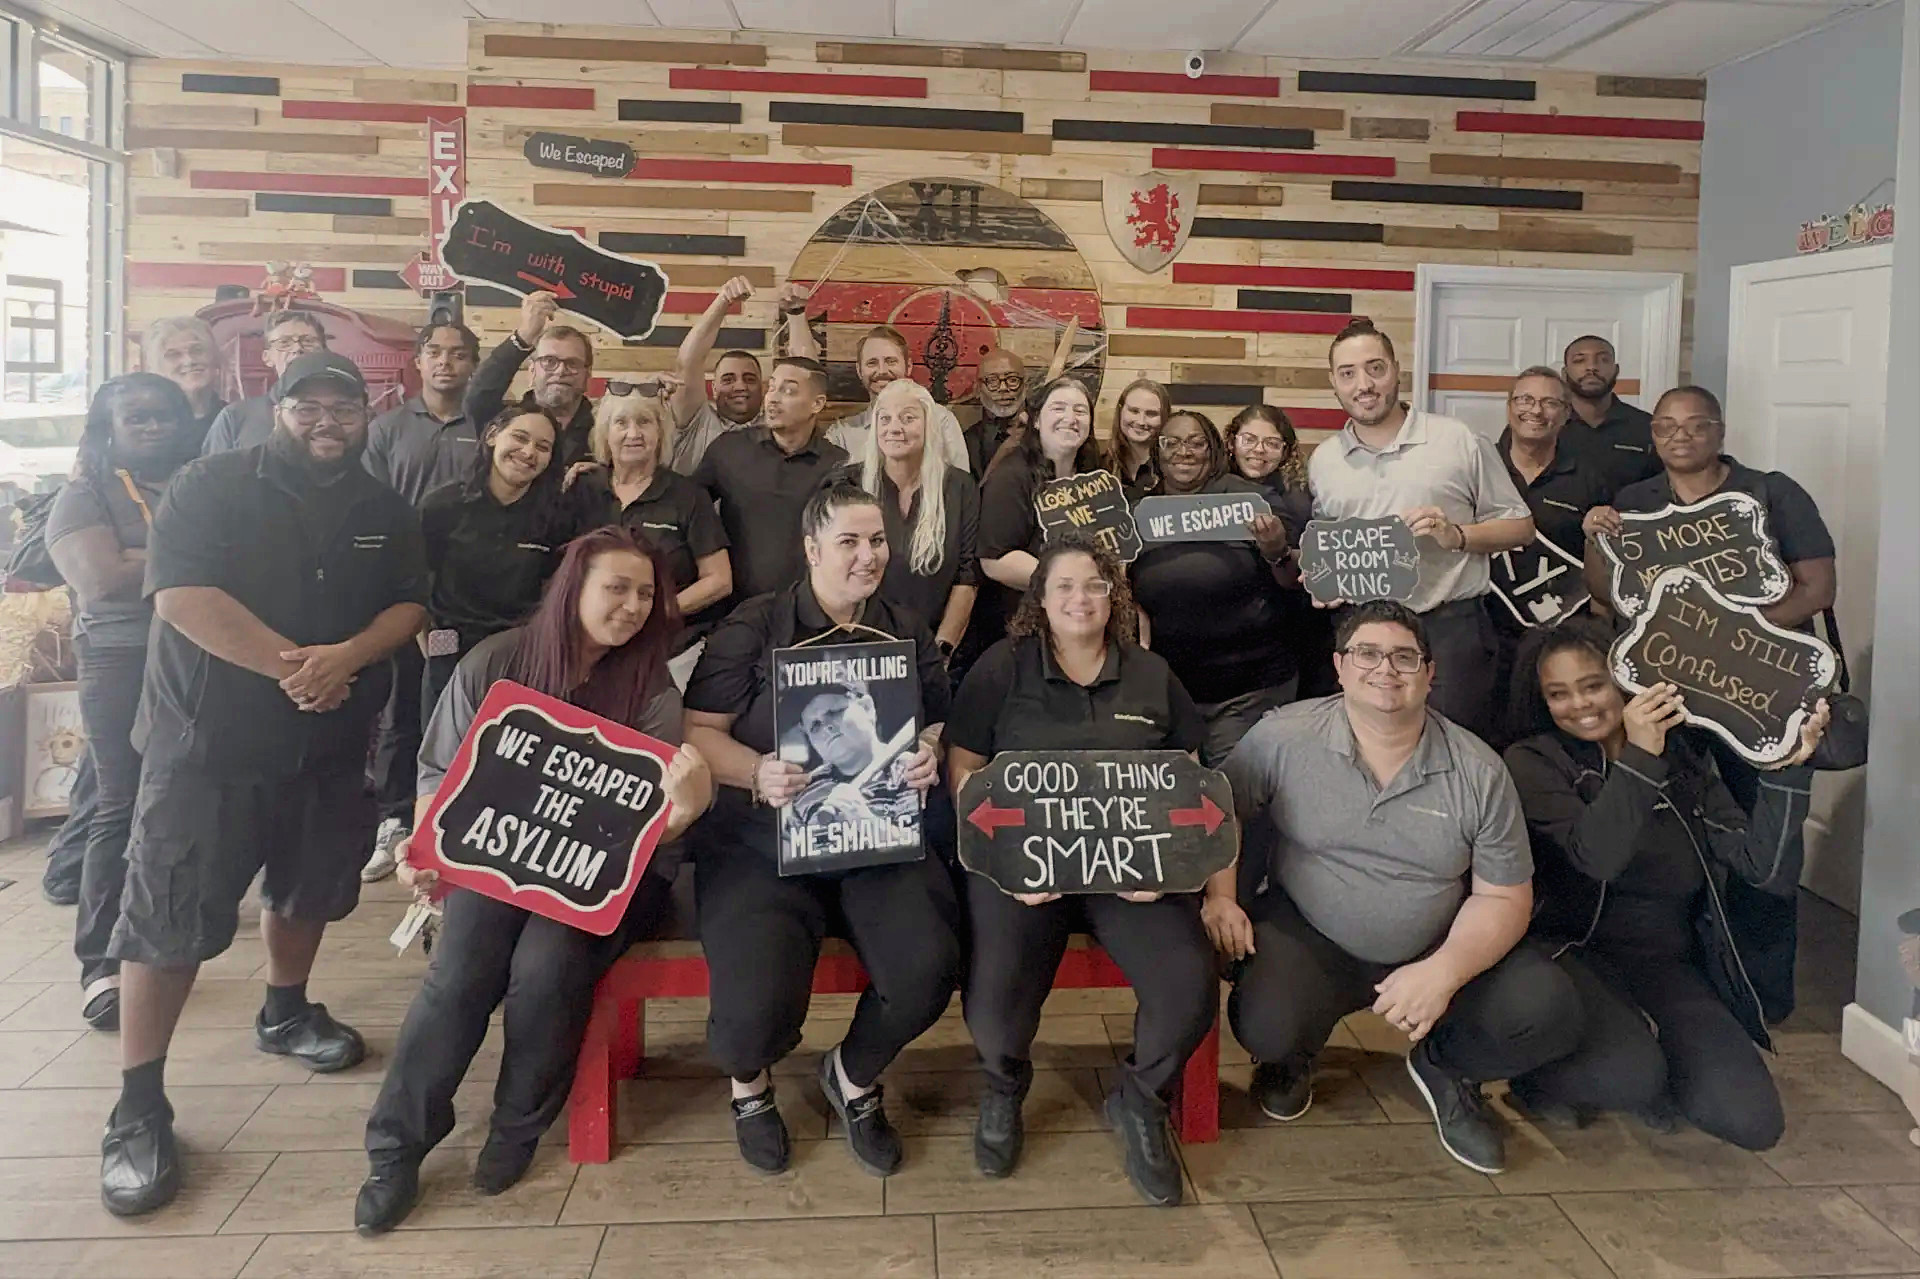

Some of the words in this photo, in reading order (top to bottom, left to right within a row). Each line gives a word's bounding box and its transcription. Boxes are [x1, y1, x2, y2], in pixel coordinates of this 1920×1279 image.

[539, 141, 561, 161] We
[564, 145, 624, 171] Escaped
[418, 274, 446, 286] OUT
[467, 224, 512, 256] I'm
[527, 252, 566, 277] with
[579, 272, 634, 300] stupid
[1064, 504, 1097, 528] WE
[1149, 515, 1176, 538] WE
[1181, 501, 1254, 533] ESCAPED
[1317, 525, 1395, 551] ESCAPE
[1620, 532, 1643, 561] 5
[1656, 512, 1739, 551] MORE
[1335, 551, 1389, 569] ROOM
[1337, 572, 1391, 597] KING
[1667, 597, 1719, 638] I'M
[1731, 628, 1801, 677] STILL
[785, 660, 842, 687] YOU'RE
[846, 655, 908, 682] KILLING
[1642, 632, 1781, 722] Confused
[495, 724, 542, 768] WE
[542, 744, 654, 812] ESCAPED
[1003, 762, 1079, 793] GOOD
[1096, 762, 1176, 790] THING
[532, 783, 584, 828] THE
[1034, 795, 1152, 831] THEY'RE
[461, 806, 608, 892] ASYLUM
[790, 823, 822, 858] ME
[1022, 832, 1172, 888] SMART
